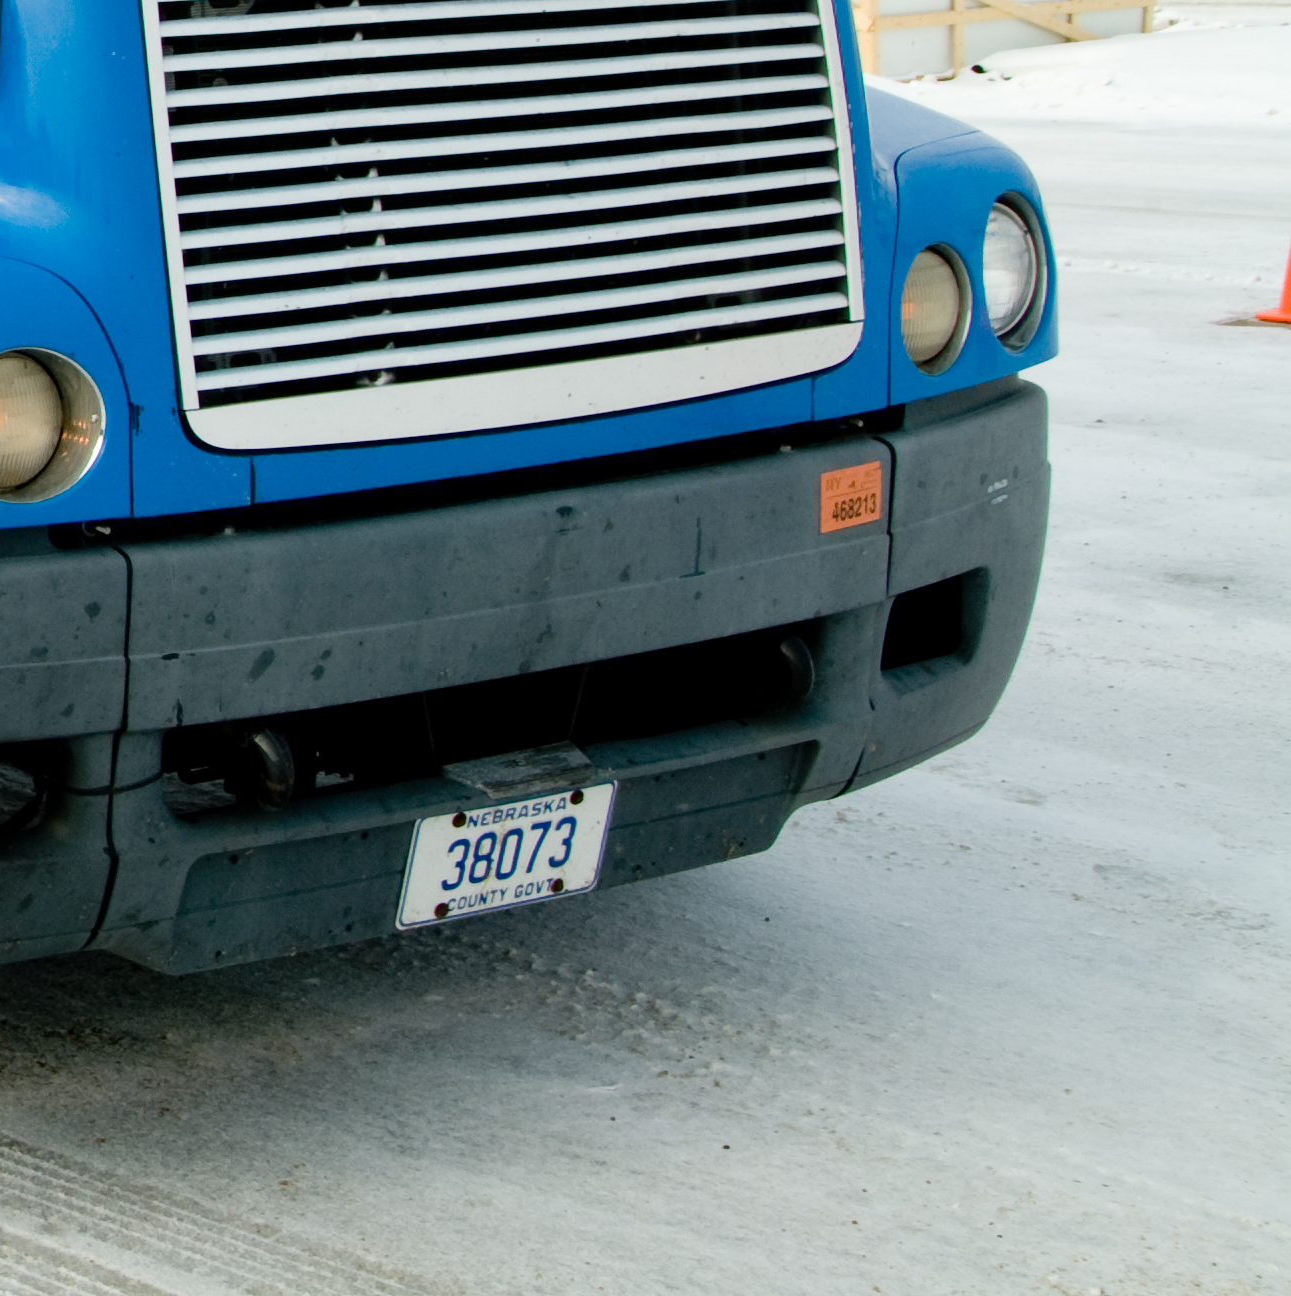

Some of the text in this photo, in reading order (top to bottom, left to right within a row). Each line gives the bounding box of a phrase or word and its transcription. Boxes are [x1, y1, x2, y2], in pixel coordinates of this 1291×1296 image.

[832, 492, 877, 522] 468213
[466, 797, 567, 829] NEBRASKA
[441, 815, 577, 891] 38073
[447, 887, 509, 912] COUNTY
